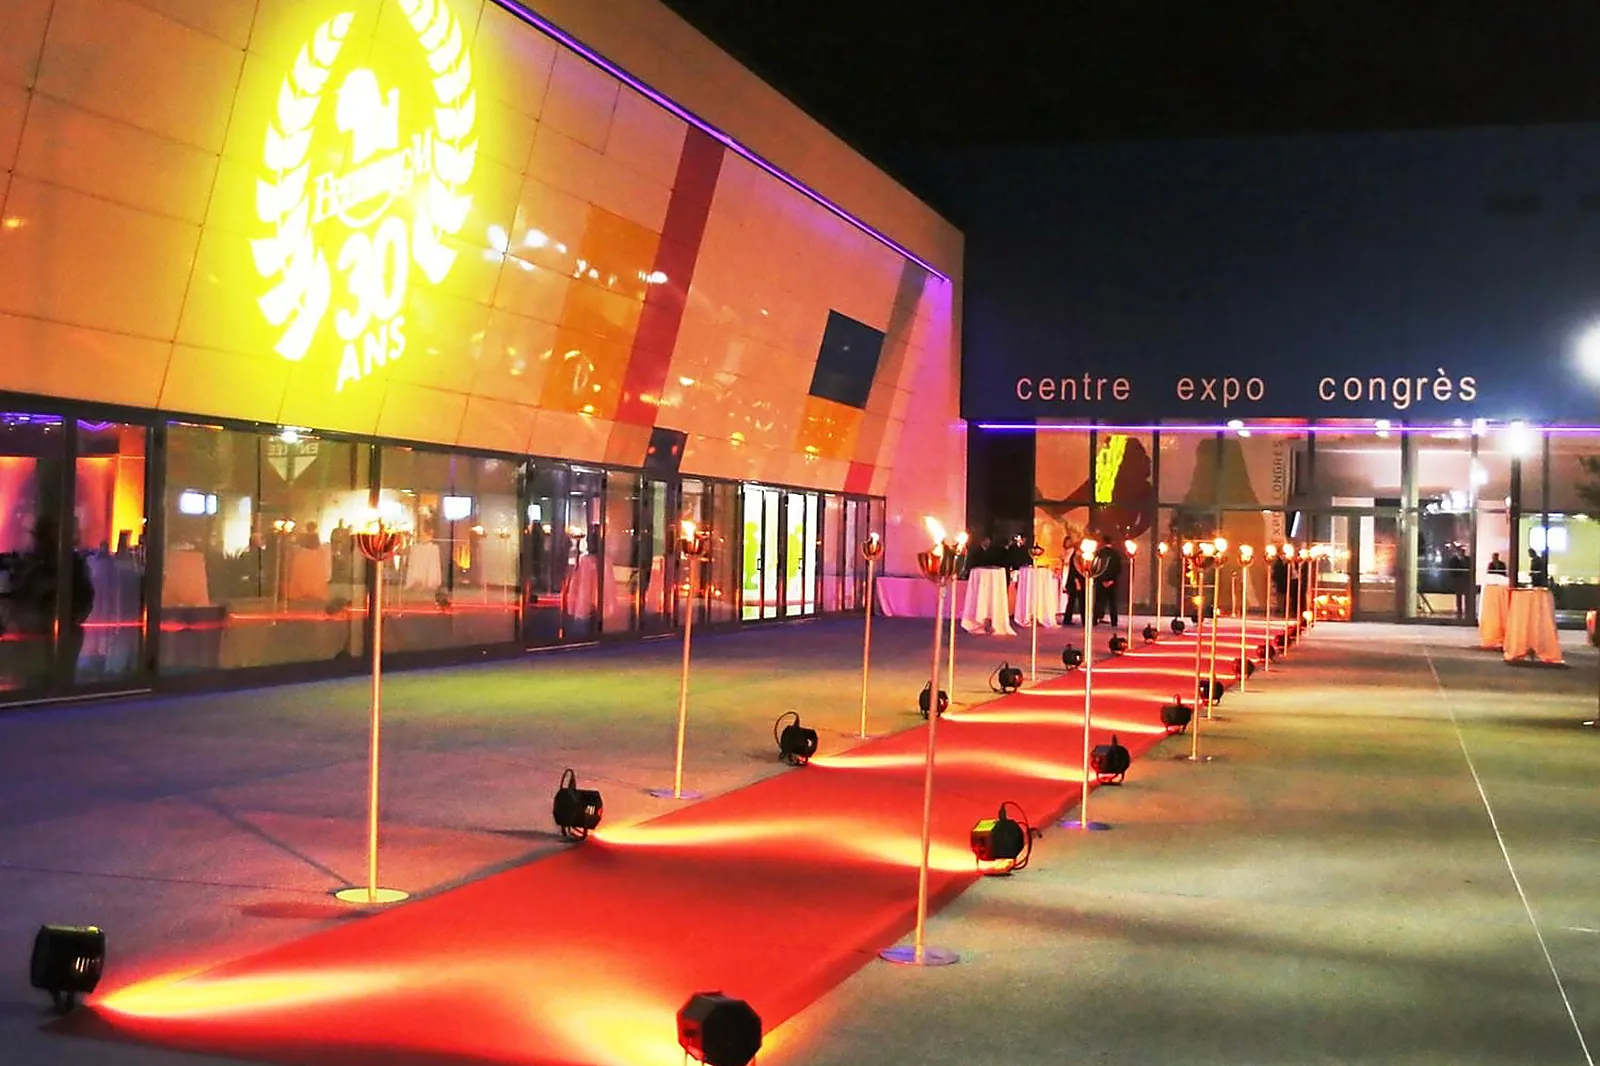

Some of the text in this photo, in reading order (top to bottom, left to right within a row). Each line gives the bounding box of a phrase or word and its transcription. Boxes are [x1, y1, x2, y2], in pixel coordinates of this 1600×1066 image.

[336, 216, 408, 340] 30
[336, 315, 405, 392] ANS
[1016, 368, 1478, 410] centre expo congrès
